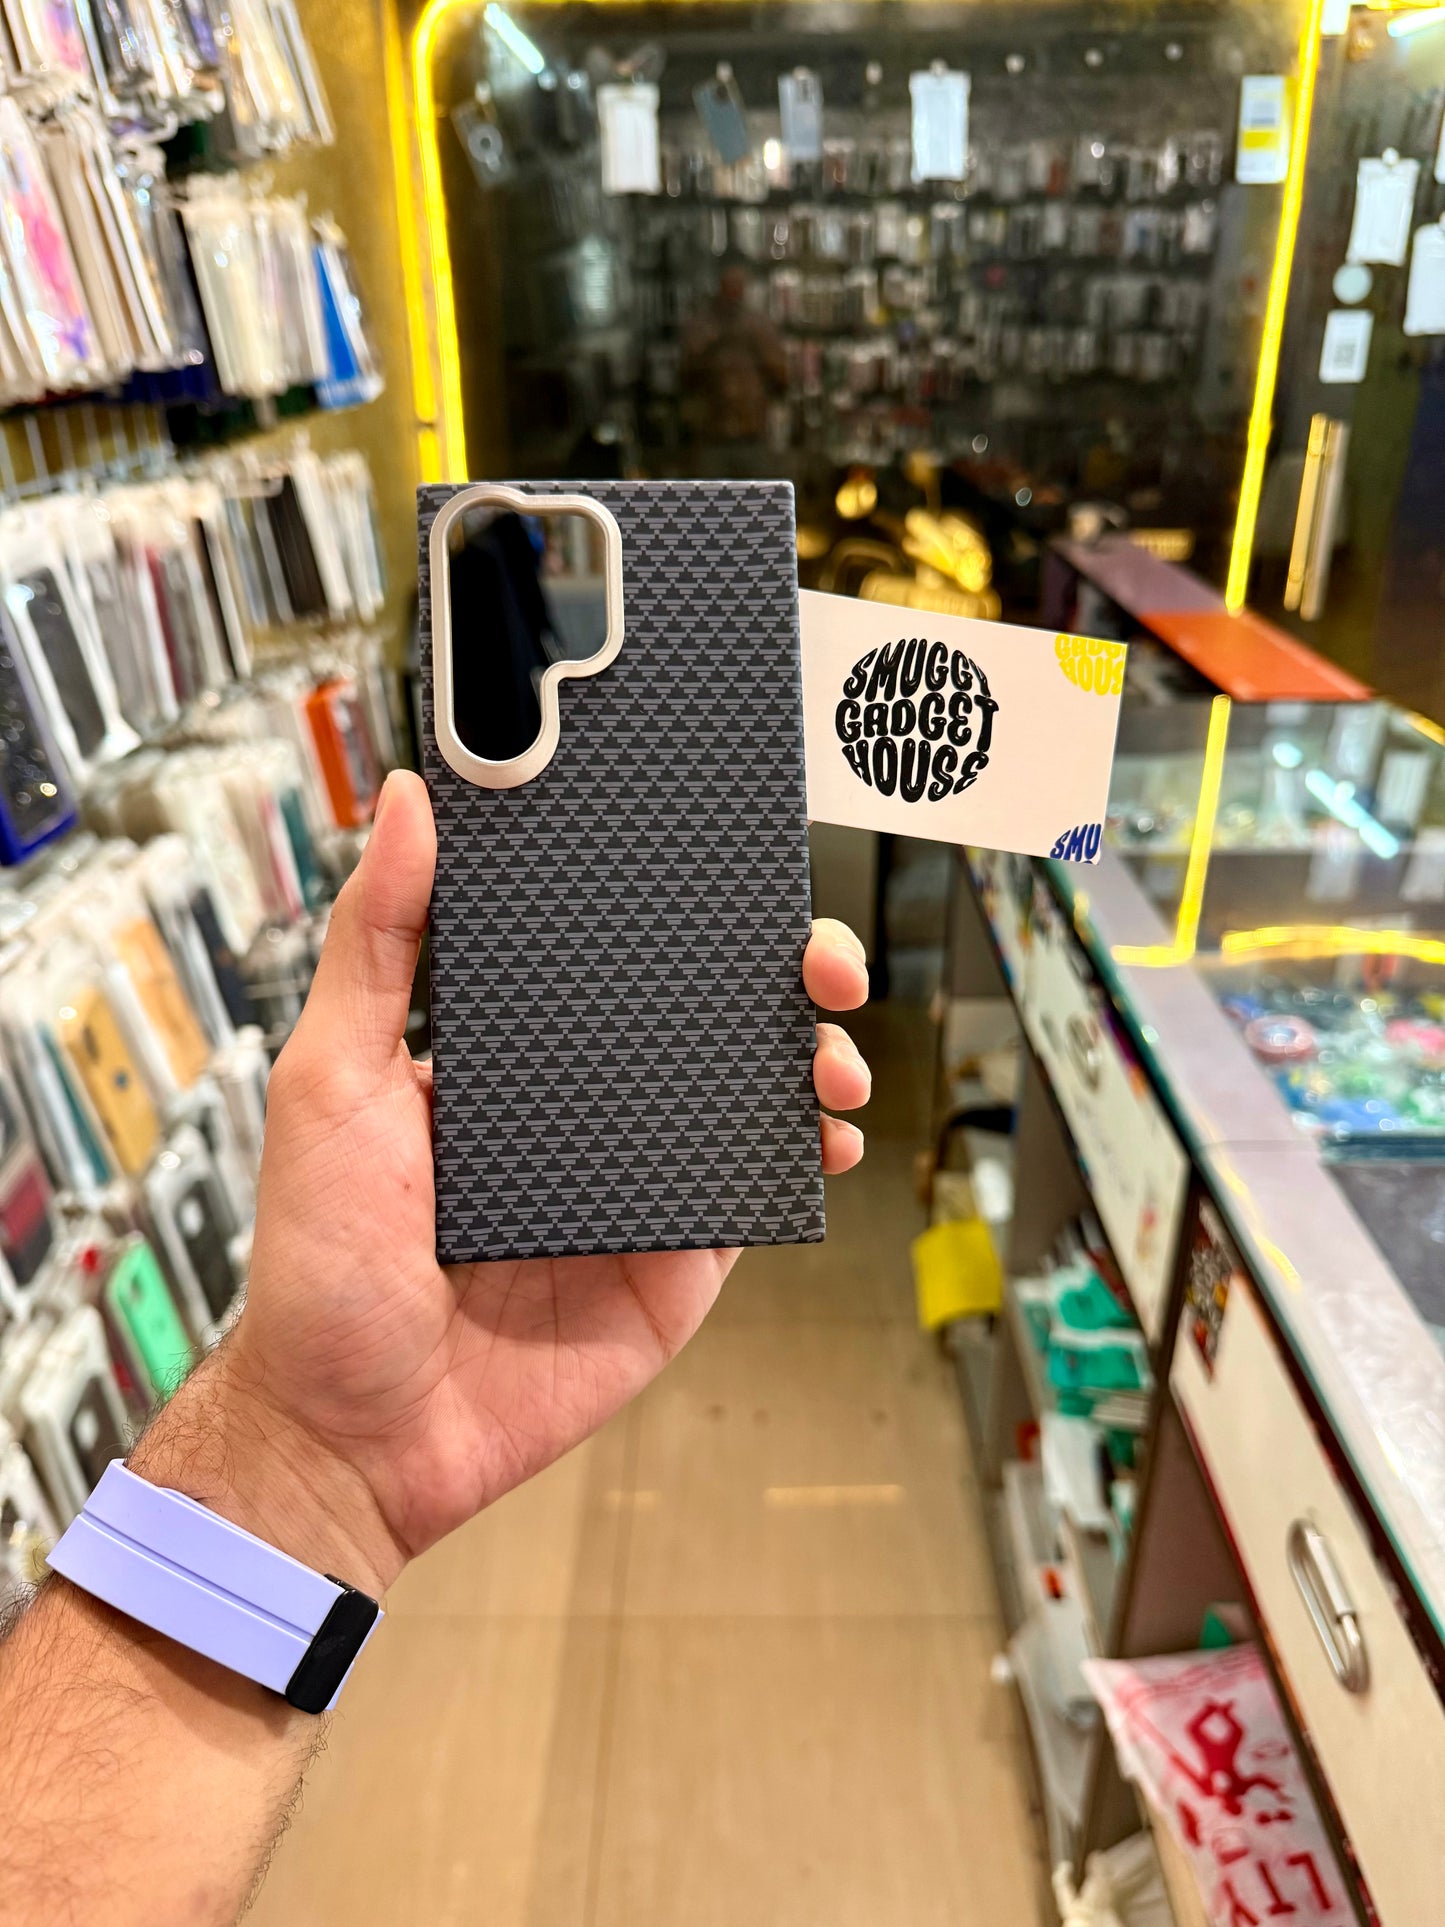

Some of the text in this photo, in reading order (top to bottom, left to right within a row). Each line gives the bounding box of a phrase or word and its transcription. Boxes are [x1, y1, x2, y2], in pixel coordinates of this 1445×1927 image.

[842, 638, 991, 701] SMUGGY
[835, 691, 999, 752] GADGET
[841, 736, 989, 803] HOUSE
[1050, 823, 1101, 862] SMU
